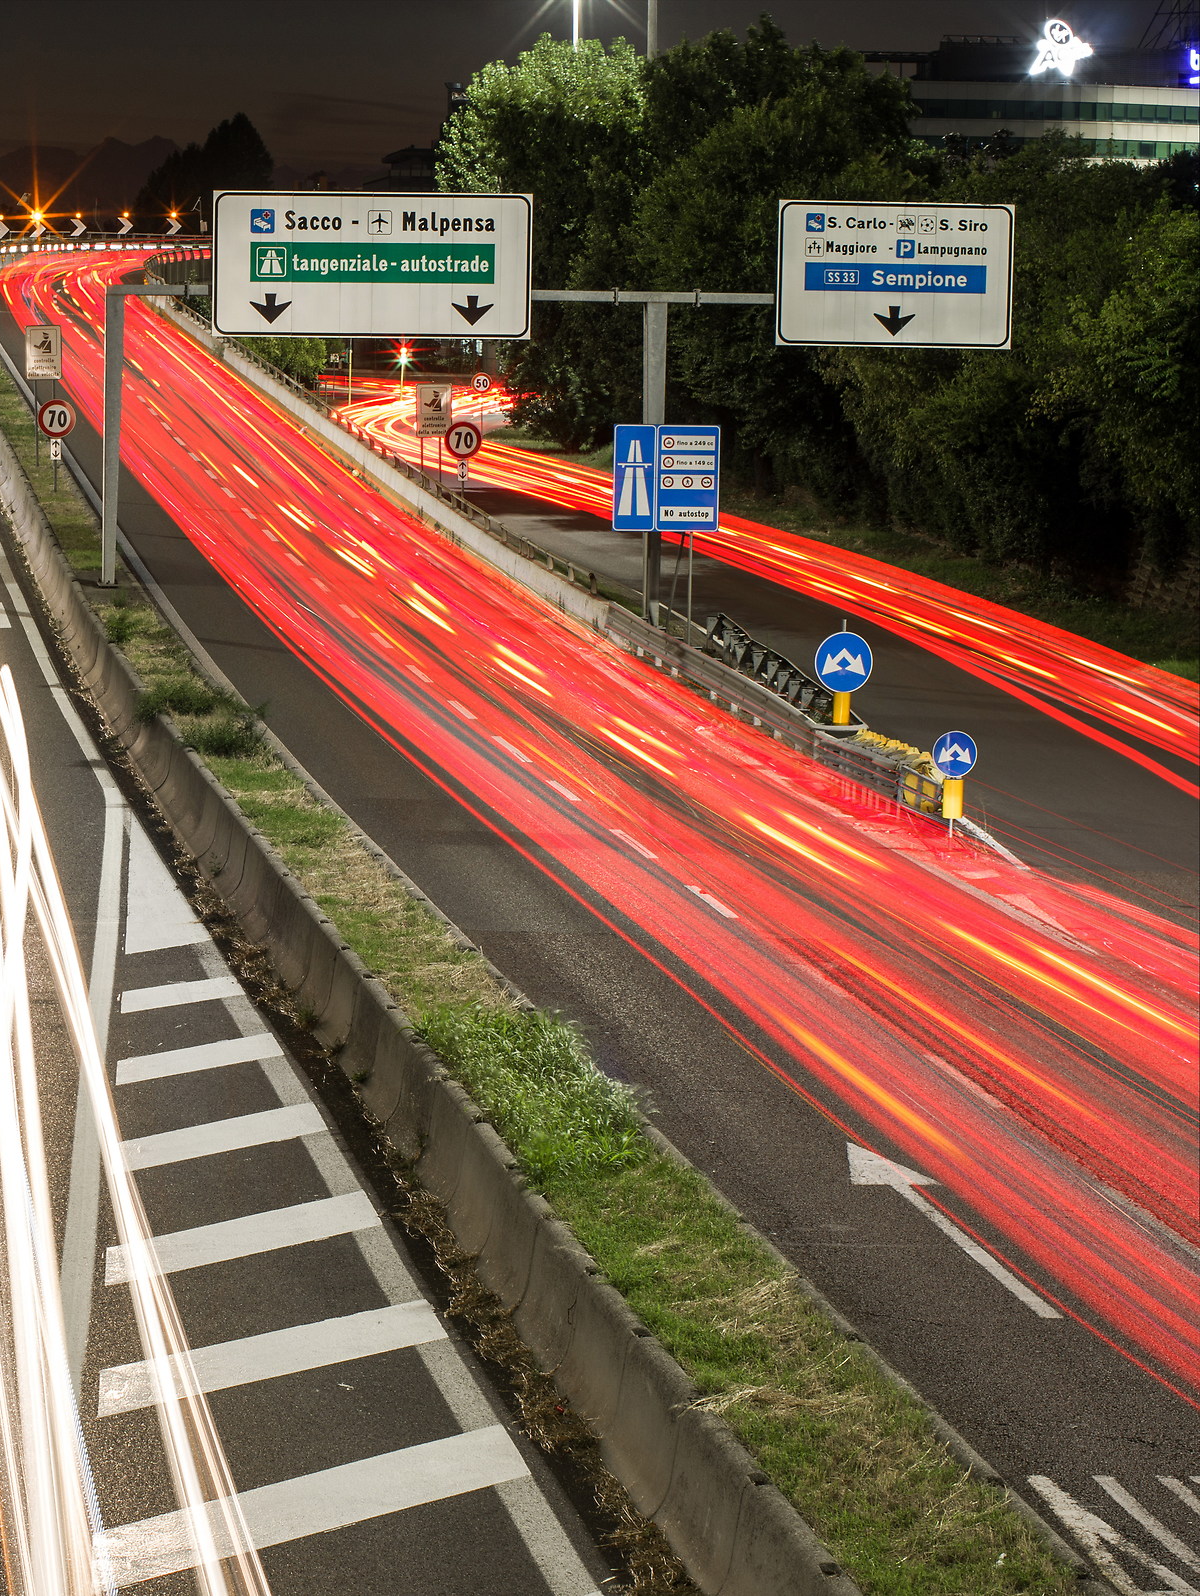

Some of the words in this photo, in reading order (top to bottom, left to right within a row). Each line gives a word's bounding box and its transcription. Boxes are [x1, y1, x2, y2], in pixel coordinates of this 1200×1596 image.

[285, 210, 342, 231] Sacco
[402, 211, 496, 237] Malpensa
[827, 217, 842, 229] S.
[939, 219, 954, 231] S.
[957, 219, 988, 232] Siro
[826, 241, 877, 256] Maggiore
[917, 242, 988, 258] Lampugnano
[871, 270, 968, 289] Sempione
[476, 379, 488, 388] 50
[48, 410, 68, 428] 70
[454, 431, 474, 449] 70
[664, 509, 674, 517] NO
[678, 510, 710, 519] autostop
